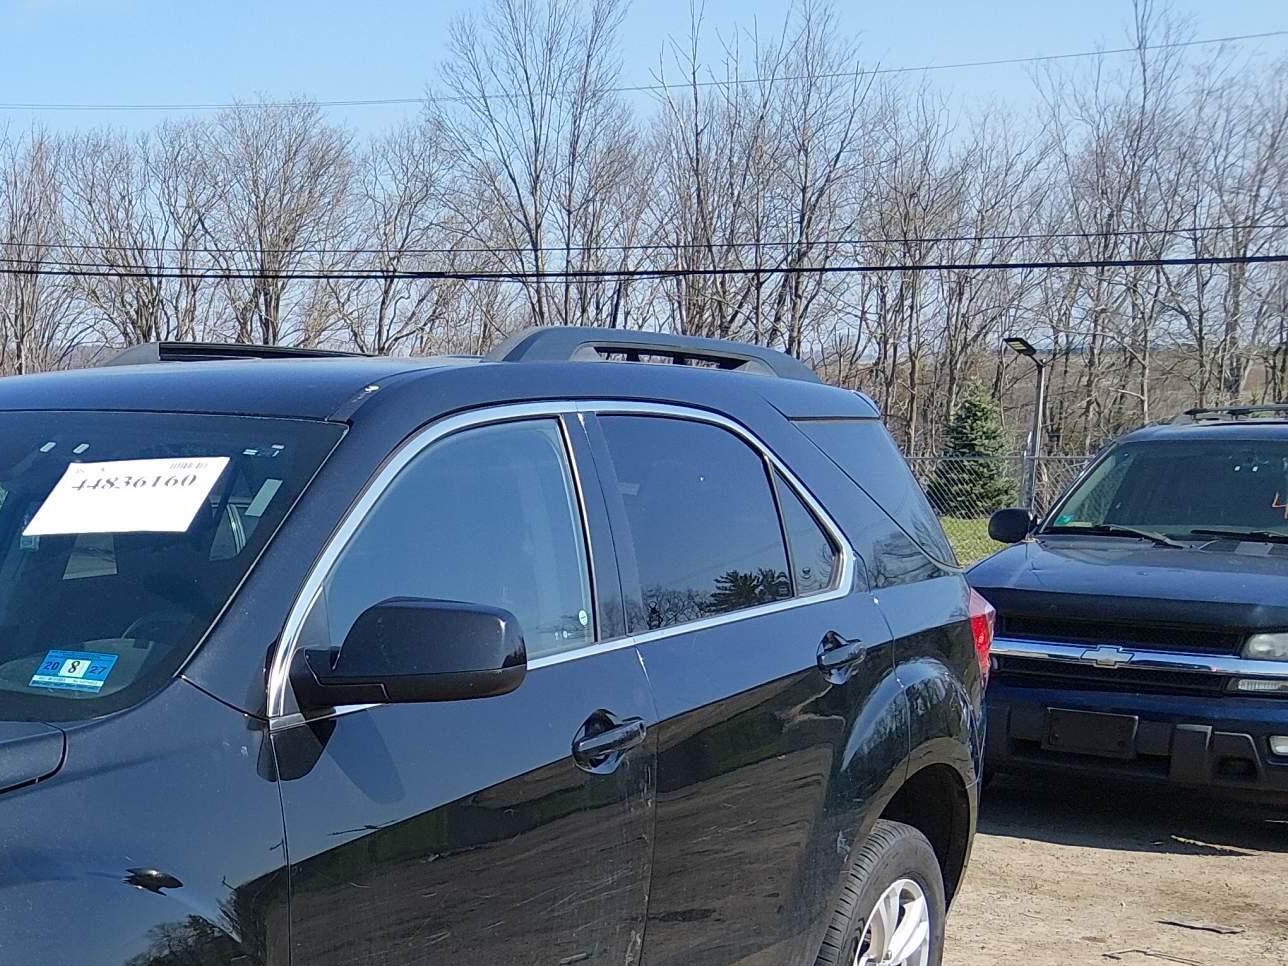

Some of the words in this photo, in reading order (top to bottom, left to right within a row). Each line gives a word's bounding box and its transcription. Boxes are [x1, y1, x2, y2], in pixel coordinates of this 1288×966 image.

[71, 474, 197, 491] 44836160
[43, 660, 61, 671] 20
[67, 660, 81, 674] 8
[88, 665, 108, 676] 27
